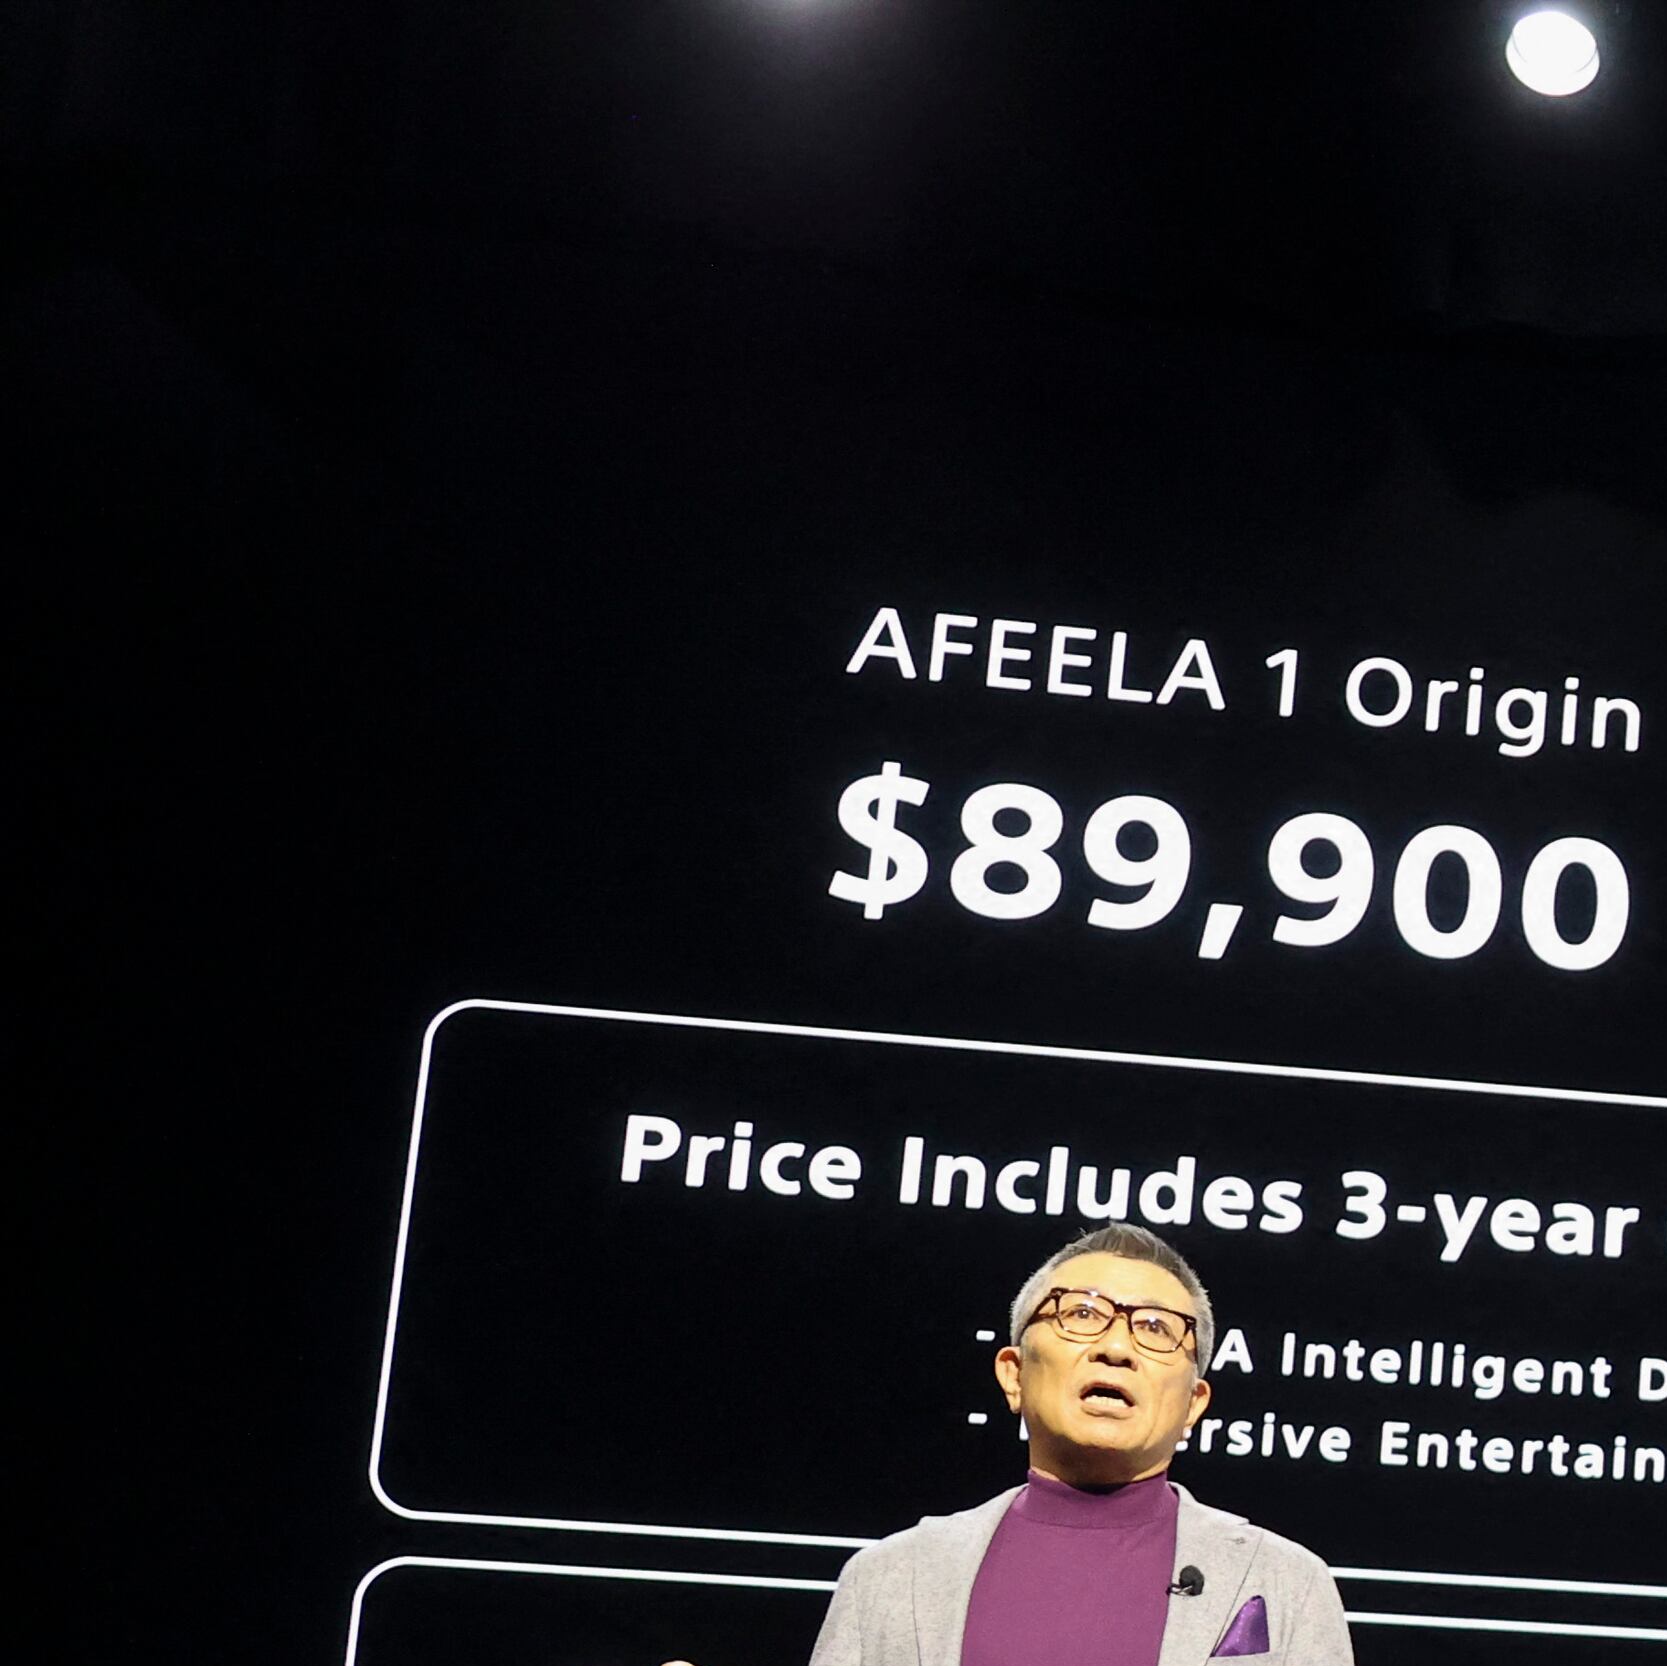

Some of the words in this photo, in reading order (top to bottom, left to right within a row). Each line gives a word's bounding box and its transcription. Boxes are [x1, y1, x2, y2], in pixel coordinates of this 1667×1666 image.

[845, 607, 1226, 711] AFEELA
[1265, 648, 1298, 717] 1
[1345, 657, 1641, 758] Origin
[828, 761, 1630, 971] $89,900
[620, 1114, 862, 1200] Price
[899, 1136, 1304, 1235] Includes
[1335, 1170, 1640, 1262] 3-year
[1281, 1332, 1612, 1400] Intelligent
